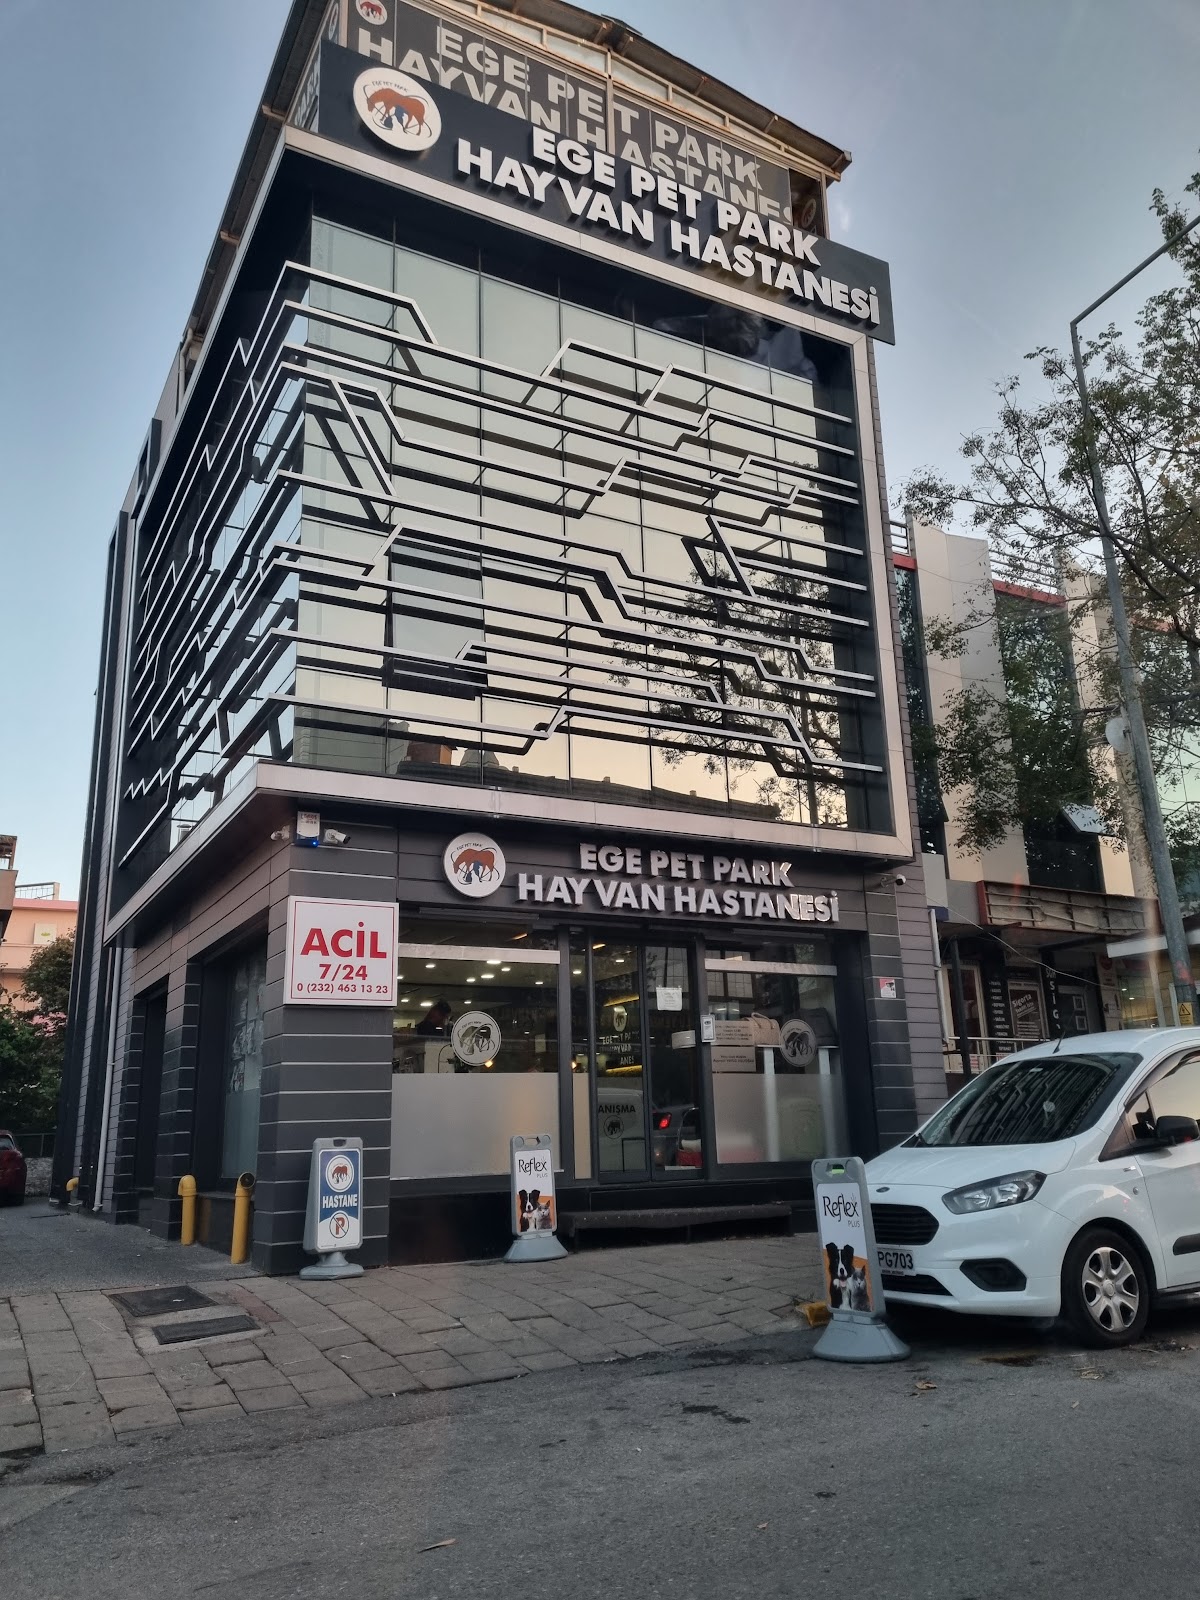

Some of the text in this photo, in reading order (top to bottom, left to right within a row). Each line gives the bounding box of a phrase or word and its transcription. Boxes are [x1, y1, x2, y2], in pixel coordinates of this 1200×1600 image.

[358, 28, 560, 134] HAYVAN
[437, 26, 763, 190] EGE PET PARK
[533, 126, 821, 266] EGE PET PARK
[458, 138, 880, 324] HAYVAN HASTANESİ
[580, 843, 794, 887] EGE PET PARK
[518, 873, 839, 922] HAYVAN HASTANESİ
[300, 921, 387, 959] ACİL
[297, 983, 388, 994] 0 (232) 463 13 23
[319, 963, 368, 981] 7/24
[598, 1104, 636, 1115] ANIŞMA
[519, 1157, 547, 1175] Reflex
[322, 1194, 357, 1209] HASTANE
[822, 1193, 859, 1222] Reflex
[848, 1220, 860, 1228] PLUS
